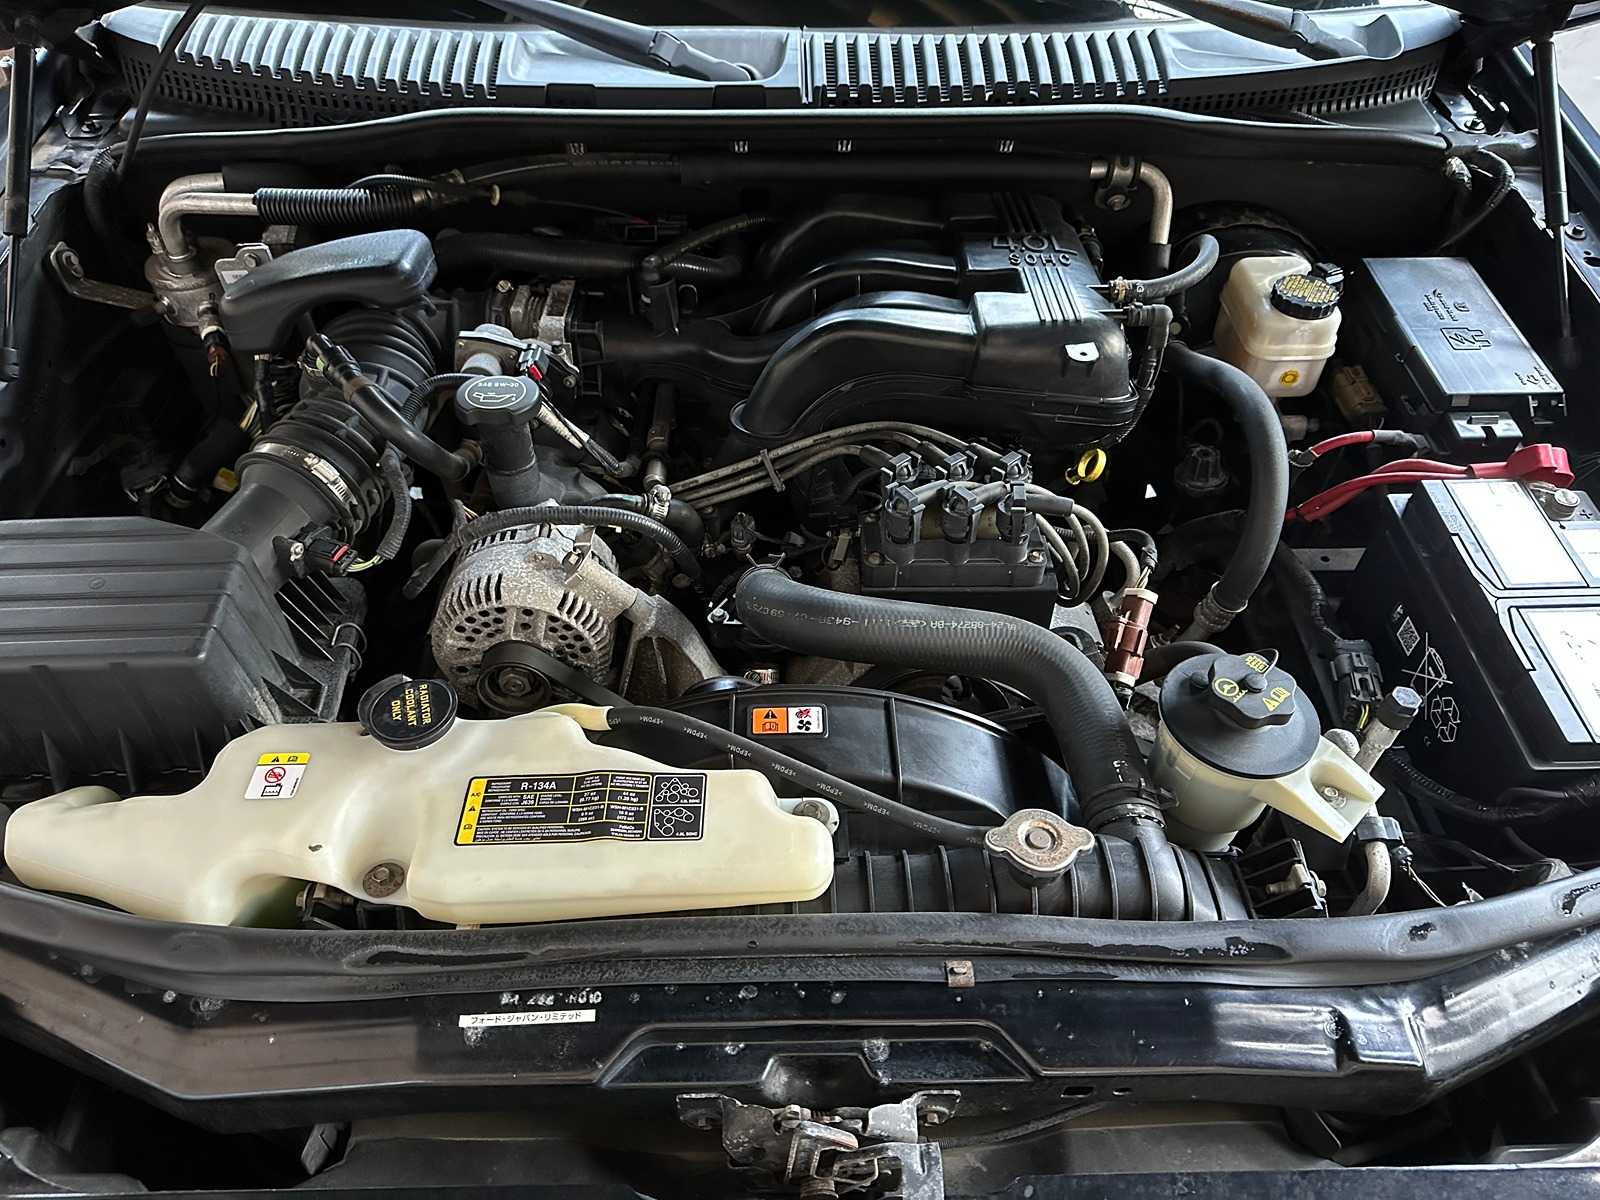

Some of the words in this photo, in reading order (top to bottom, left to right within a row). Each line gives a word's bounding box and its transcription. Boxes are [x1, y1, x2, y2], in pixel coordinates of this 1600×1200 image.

[993, 235, 1078, 256] 4.0L
[1008, 252, 1071, 267] SOHC
[391, 699, 402, 721] ONLY
[405, 688, 417, 726] COOLANT
[419, 683, 432, 725] RADIATOR
[520, 781, 557, 791] R-134A
